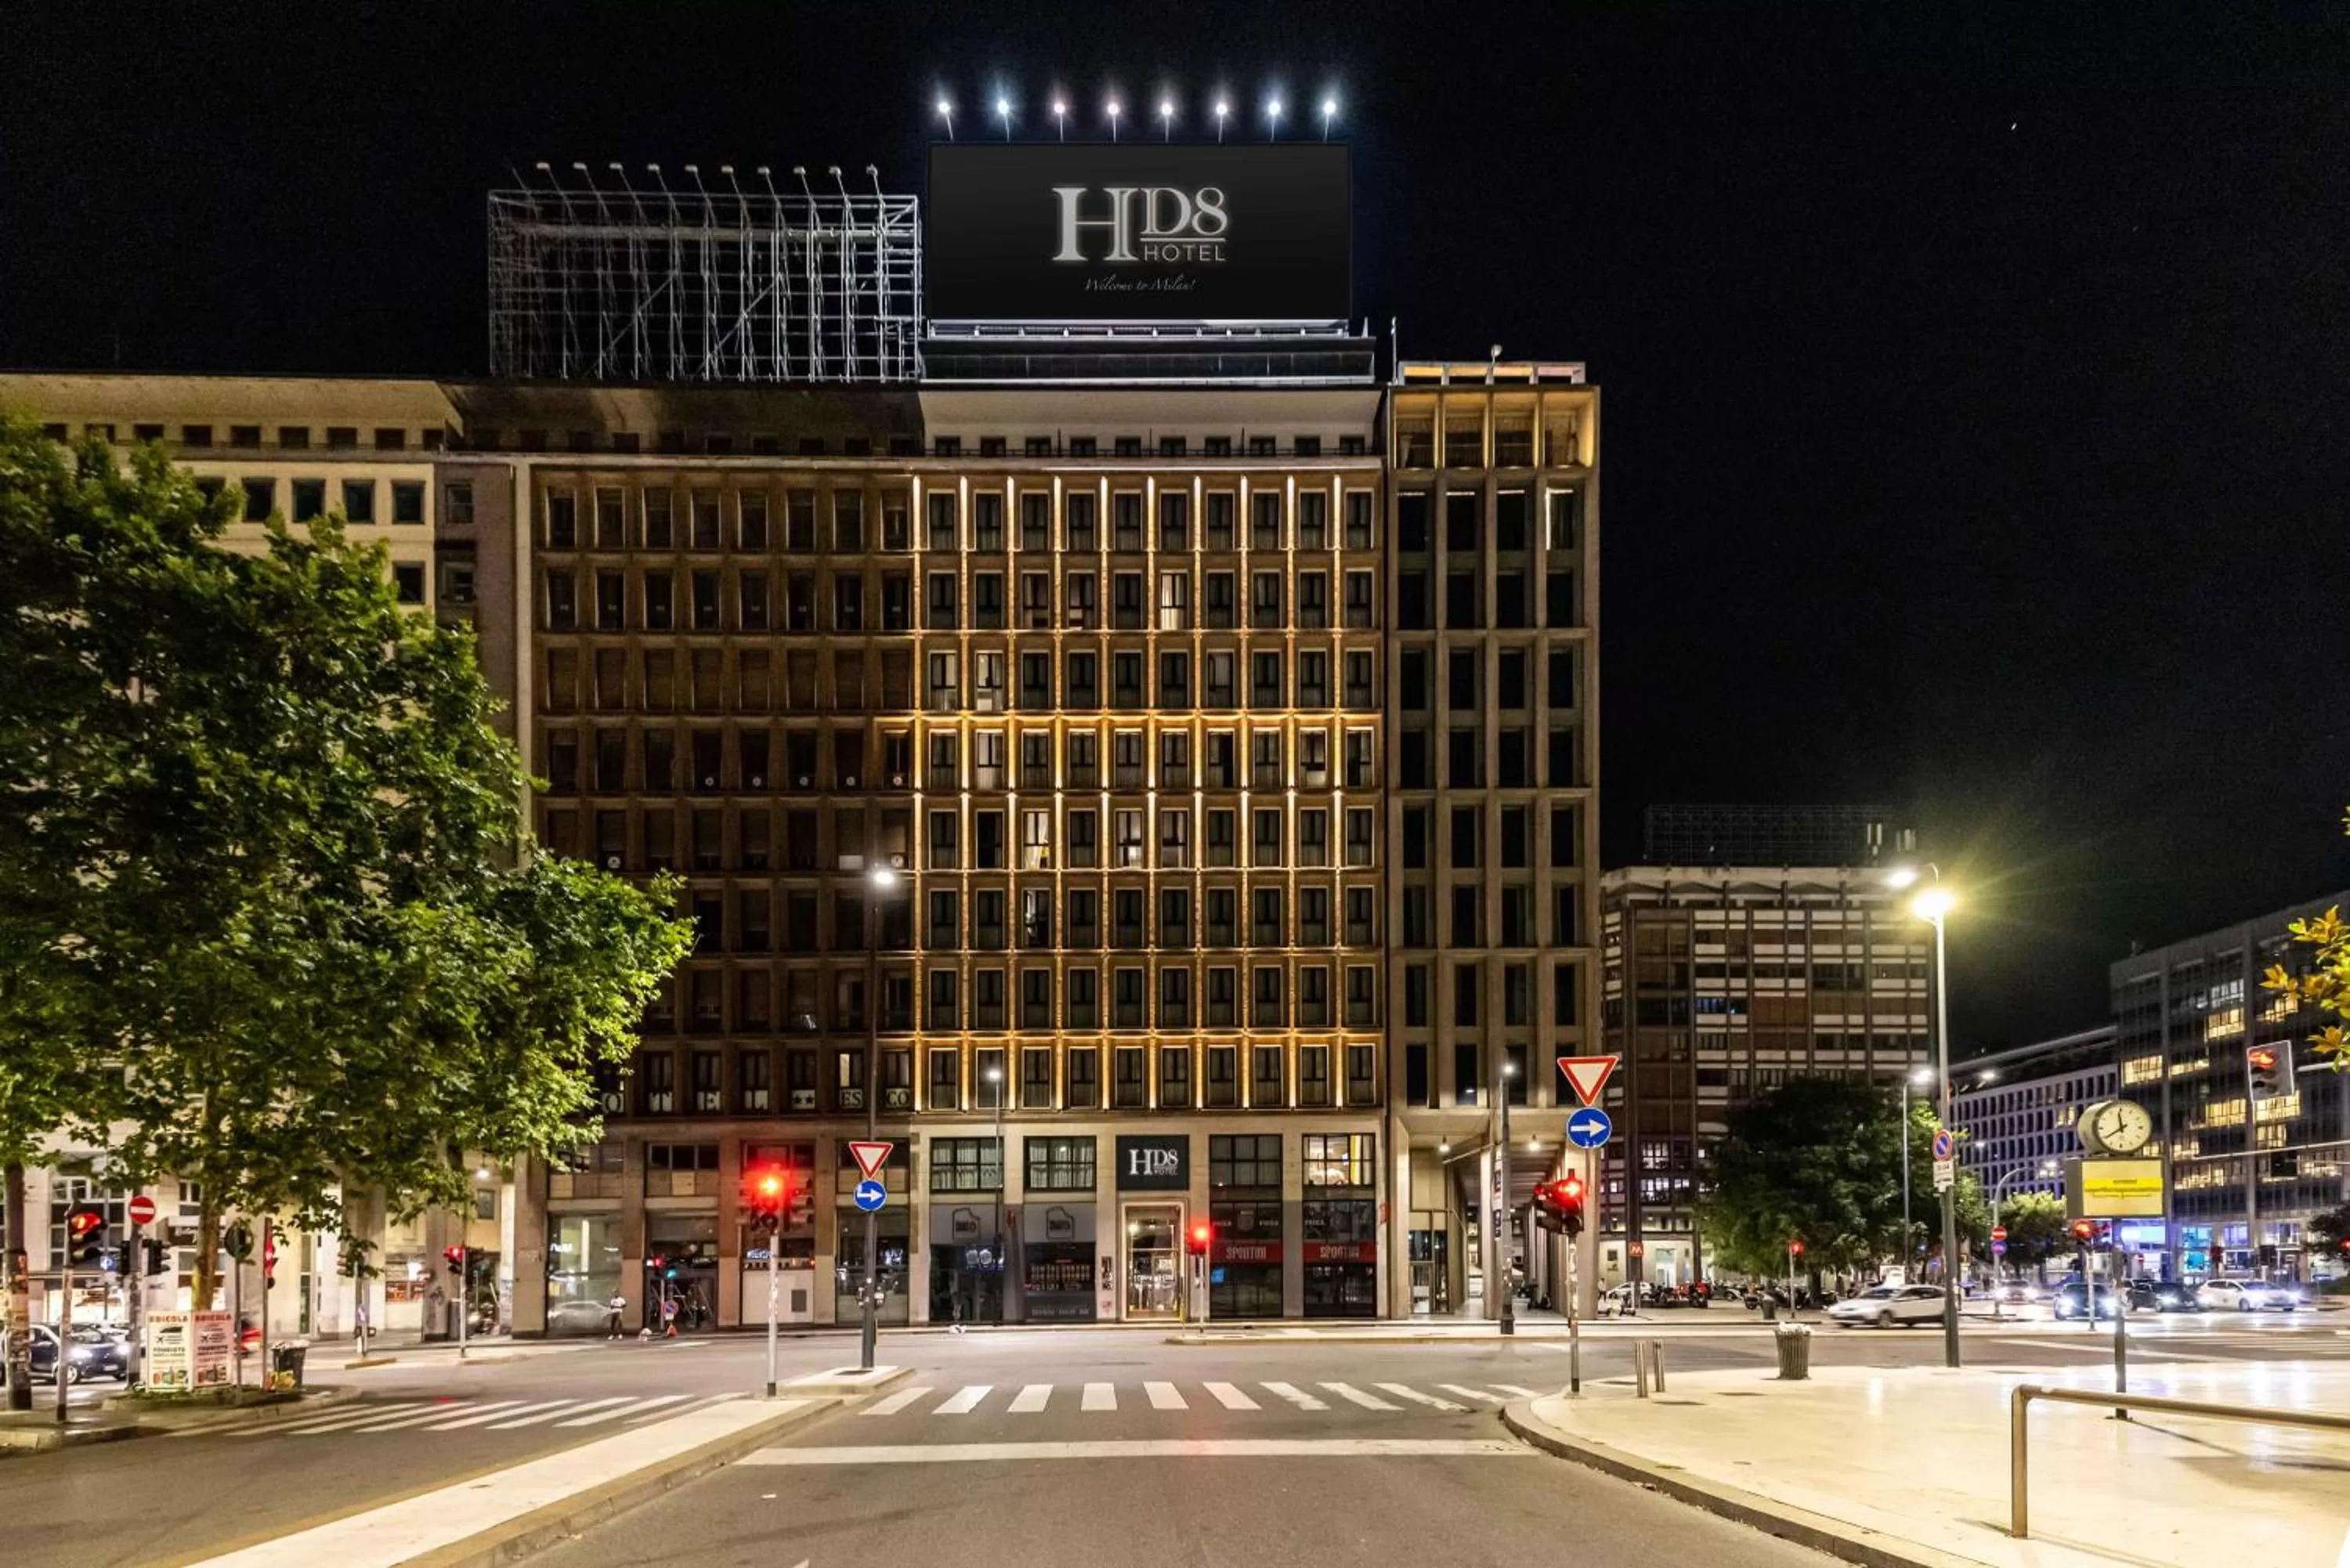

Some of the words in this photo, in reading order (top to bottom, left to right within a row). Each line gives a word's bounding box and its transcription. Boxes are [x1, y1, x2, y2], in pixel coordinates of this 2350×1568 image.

[1144, 244, 1226, 262] HOTEL
[1084, 273, 1133, 291] Welcome
[1136, 280, 1148, 291] to
